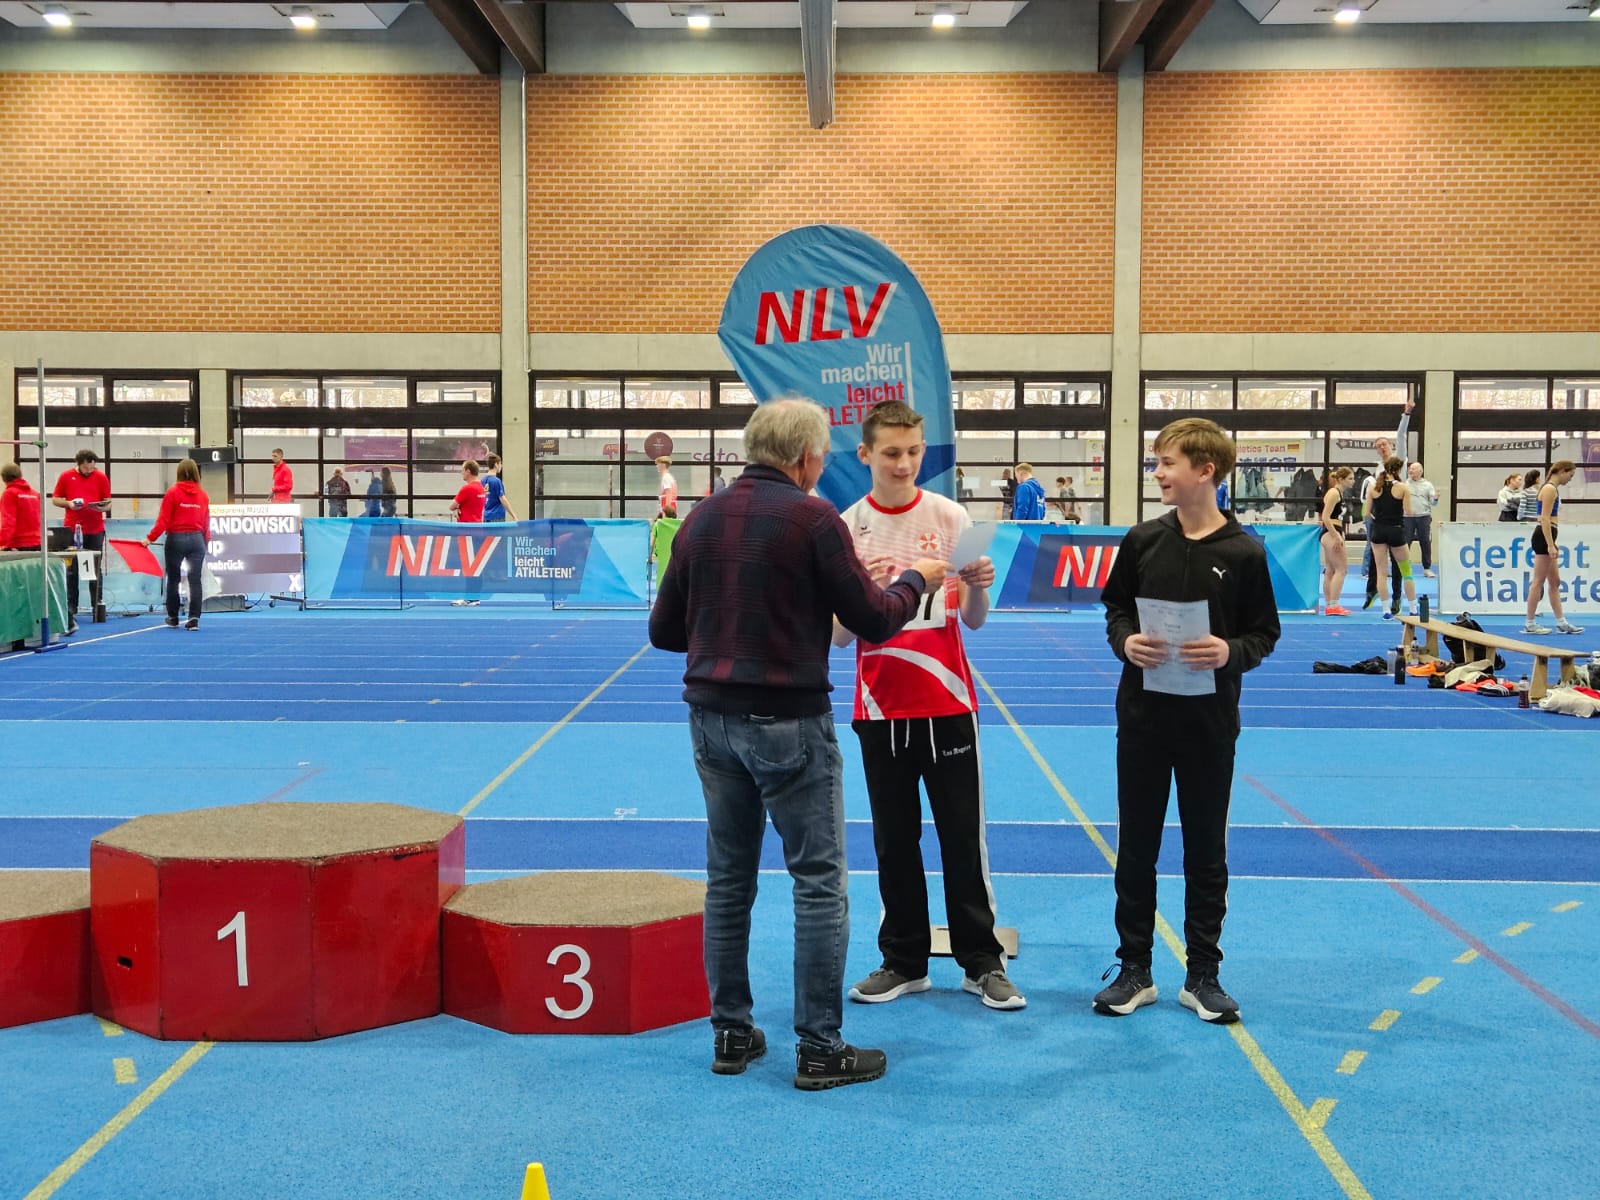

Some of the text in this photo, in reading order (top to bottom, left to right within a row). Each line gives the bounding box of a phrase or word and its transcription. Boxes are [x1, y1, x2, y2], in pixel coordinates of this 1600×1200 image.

[755, 282, 898, 345] NLV
[866, 343, 903, 365] Wir
[821, 361, 904, 384] machen
[847, 381, 905, 404] leicht
[209, 517, 295, 533] ANDOWSKI
[514, 546, 557, 556] machen
[515, 536, 534, 547] Wir
[82, 559, 89, 573] 1
[386, 535, 501, 577] NLV
[514, 556, 545, 568] leicht
[217, 911, 249, 988] 1
[544, 943, 594, 1021] 3
